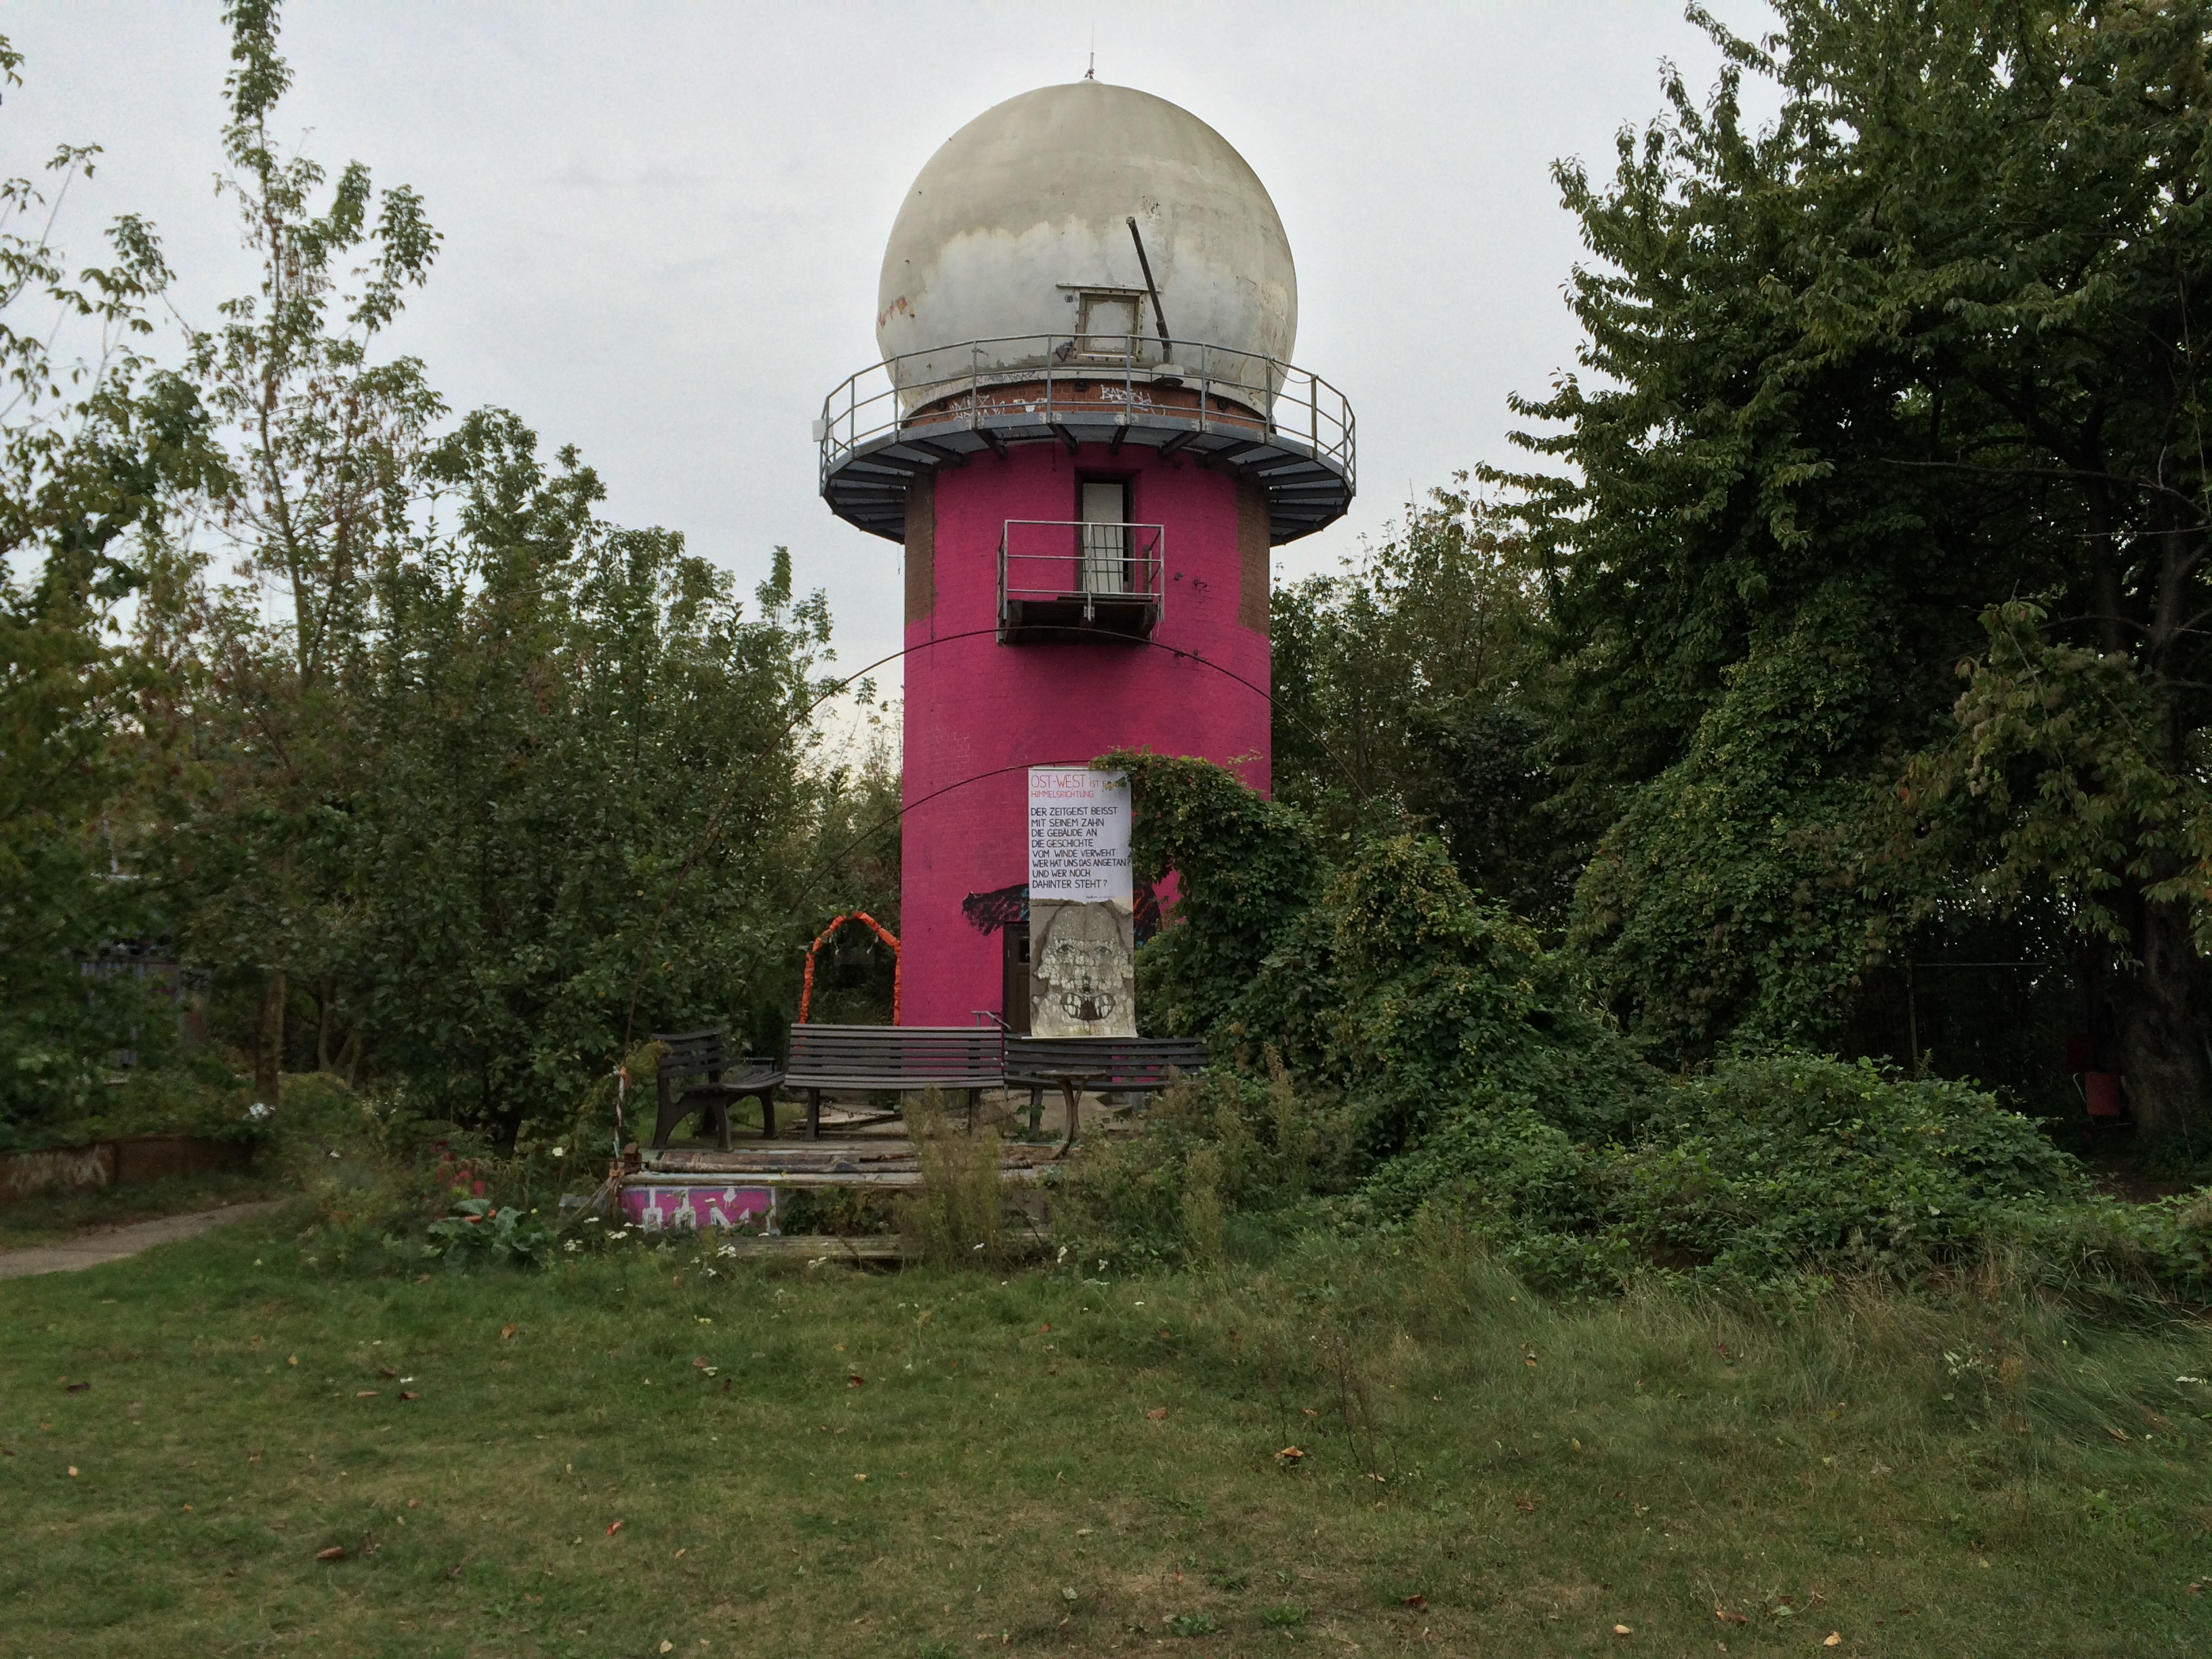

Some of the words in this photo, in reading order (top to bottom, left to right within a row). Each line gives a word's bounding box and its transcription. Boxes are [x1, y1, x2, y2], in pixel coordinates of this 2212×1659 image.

[1031, 775, 1086, 788] OST-WEST
[1031, 808, 1047, 816] DER
[1049, 806, 1088, 816] ZEITGEIST
[1091, 806, 1118, 815] BEISST
[1031, 819, 1046, 827] MIT
[1049, 819, 1078, 827] SEINEM
[1082, 818, 1104, 827] ZAHN
[1031, 829, 1044, 837] DIE
[1047, 827, 1082, 837] GEBÄUDE
[1086, 828, 1097, 836] AN
[1031, 840, 1044, 848] DIE
[1047, 839, 1093, 848] GESCHICHTE
[1033, 850, 1050, 858] VOM
[1054, 849, 1078, 858] WINDE
[1081, 848, 1116, 857] VERWEHT
[1032, 859, 1048, 867] WER
[1050, 859, 1062, 867] HAT
[1064, 859, 1078, 867] UNS
[1079, 859, 1092, 867] DAS
[1092, 858, 1131, 867] ANGETAN?
[1032, 869, 1049, 878] UND
[1051, 869, 1067, 878] WER
[1069, 869, 1090, 877] NOCH
[1032, 880, 1072, 888] DAHINTER
[1075, 880, 1101, 888] STEHT
